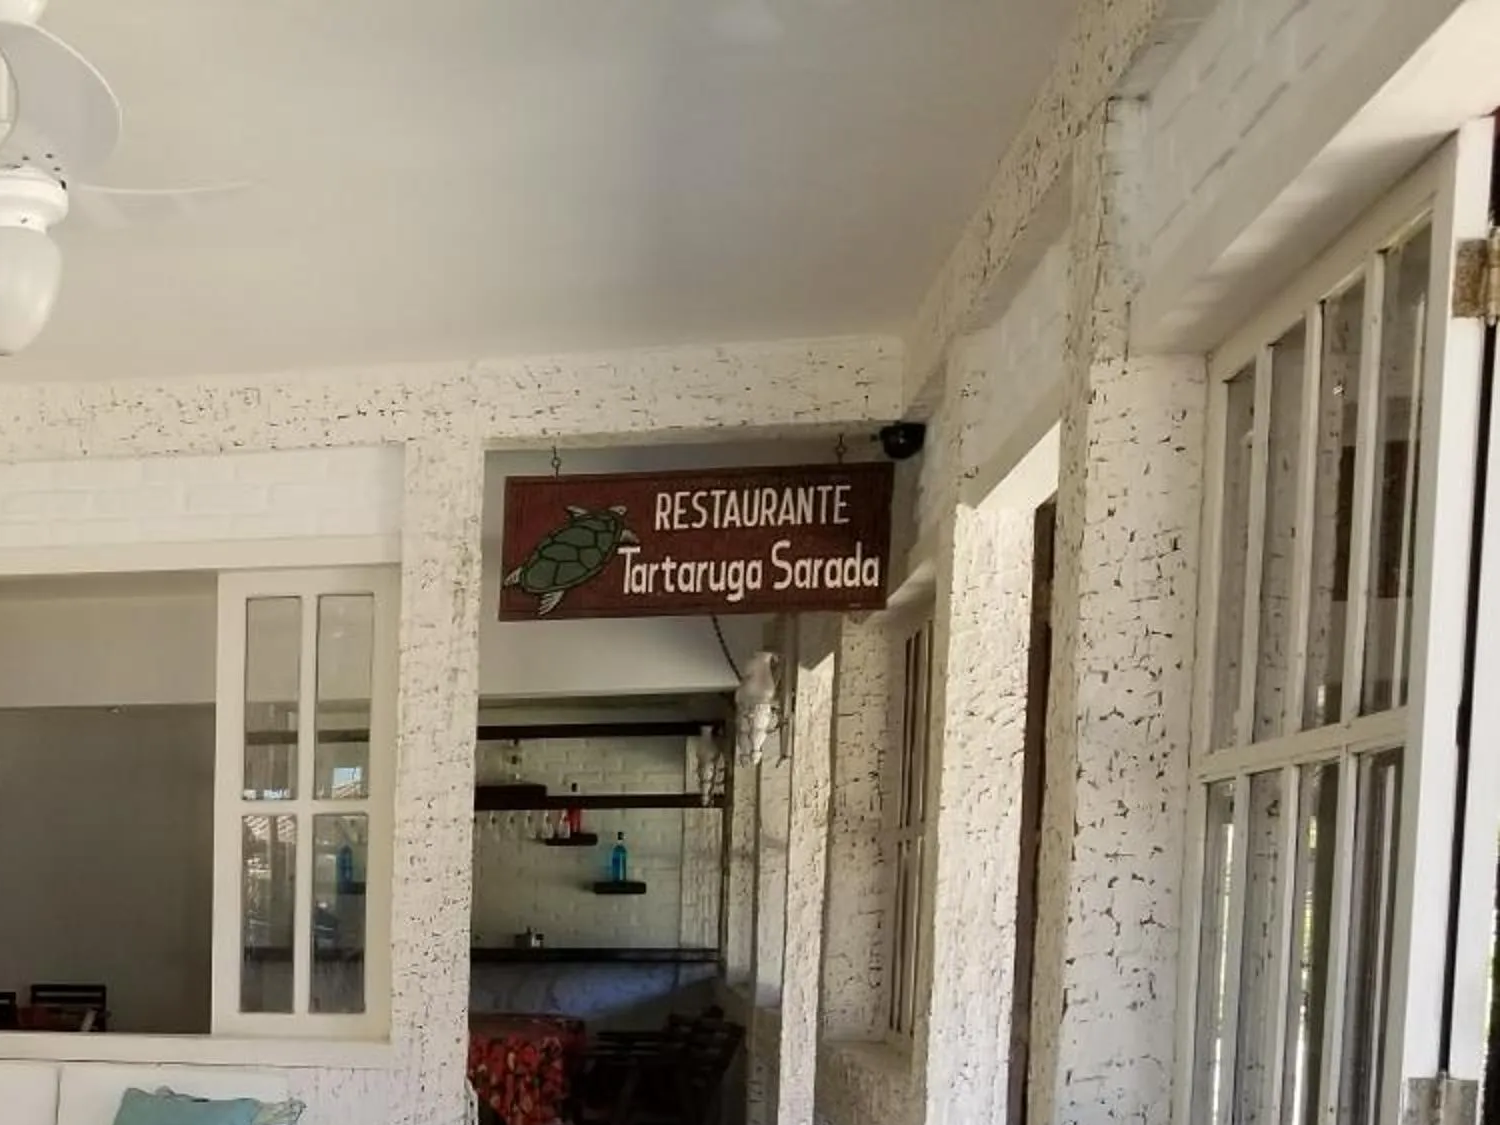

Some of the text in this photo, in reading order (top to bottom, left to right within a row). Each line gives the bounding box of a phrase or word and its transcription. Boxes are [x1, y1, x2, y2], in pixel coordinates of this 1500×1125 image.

[654, 486, 850, 531] RESTAURANTE
[617, 541, 880, 601] Tartaruga Sarada
